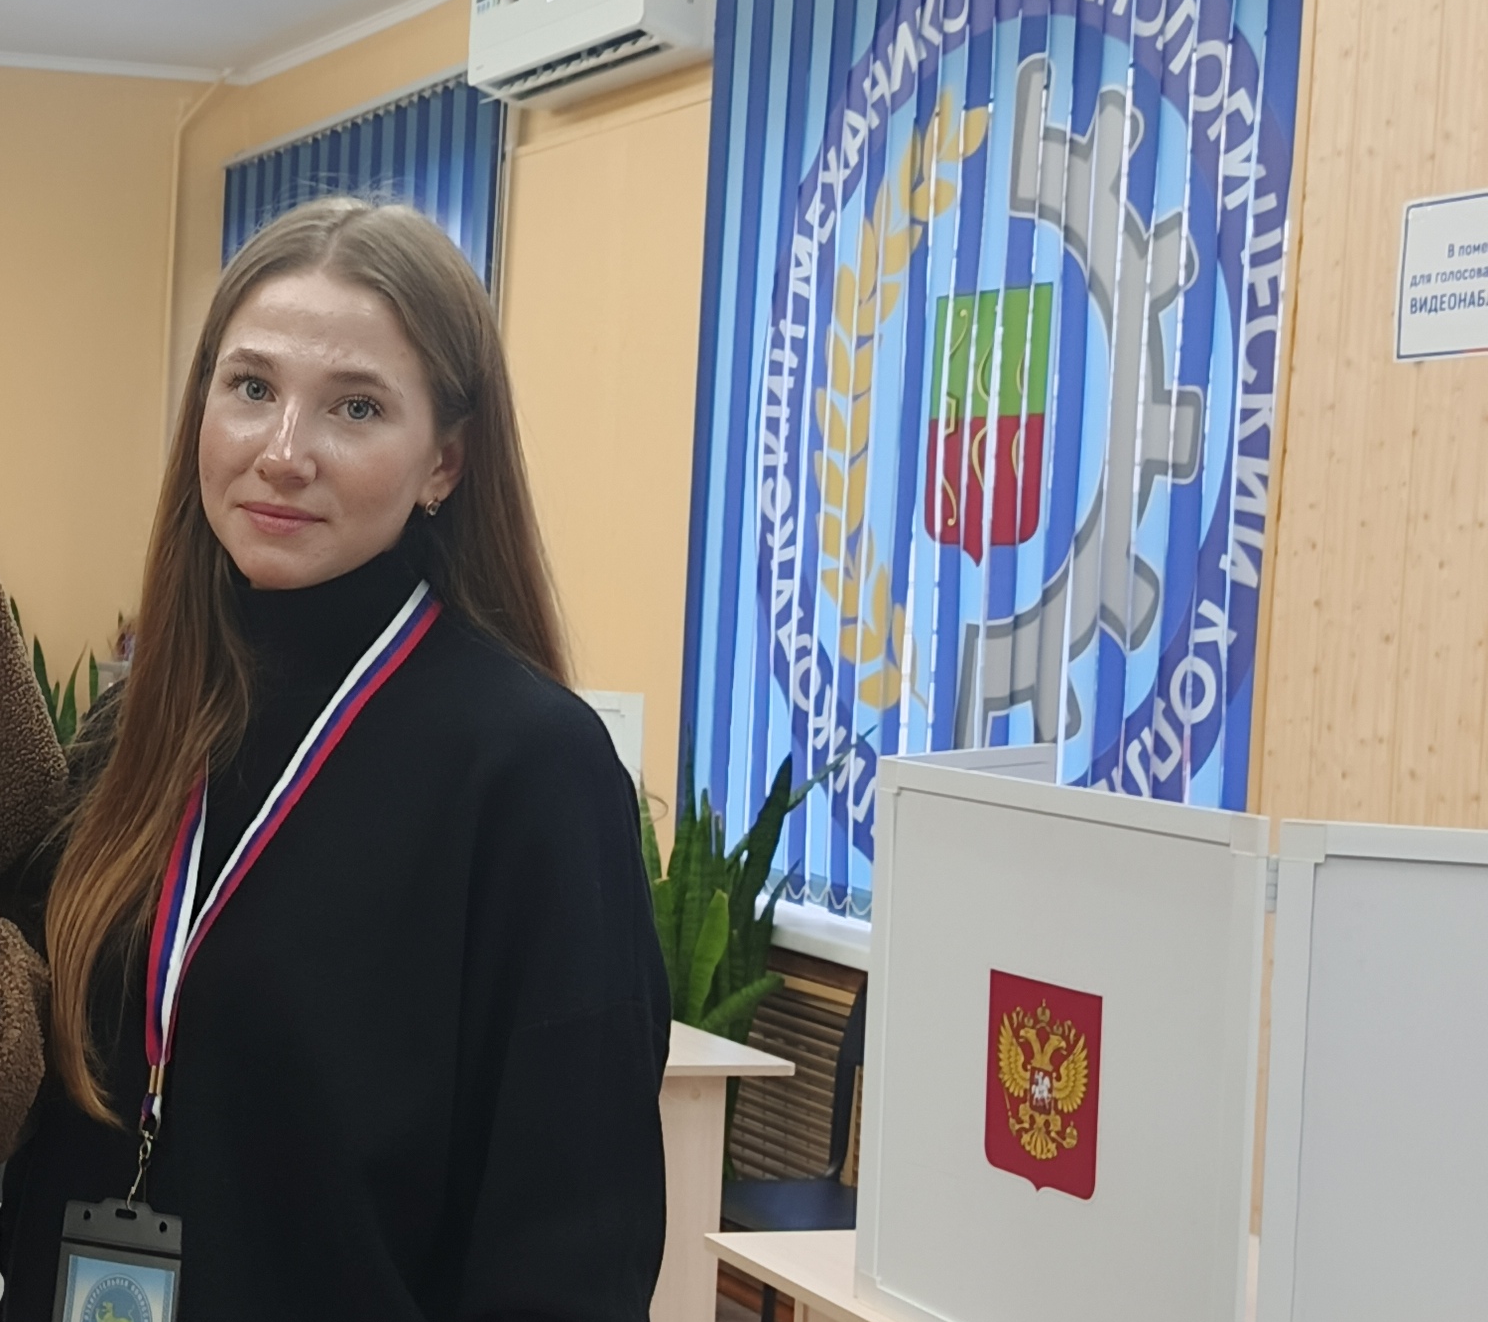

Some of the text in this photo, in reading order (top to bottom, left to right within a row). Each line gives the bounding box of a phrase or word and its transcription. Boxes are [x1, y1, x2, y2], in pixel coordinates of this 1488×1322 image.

[1447, 243, 1455, 258] В
[1410, 273, 1432, 289] для
[760, 318, 877, 834] ЛИКОЛУКСКИЙ
[1090, 598, 1238, 798] КОЛЛ
